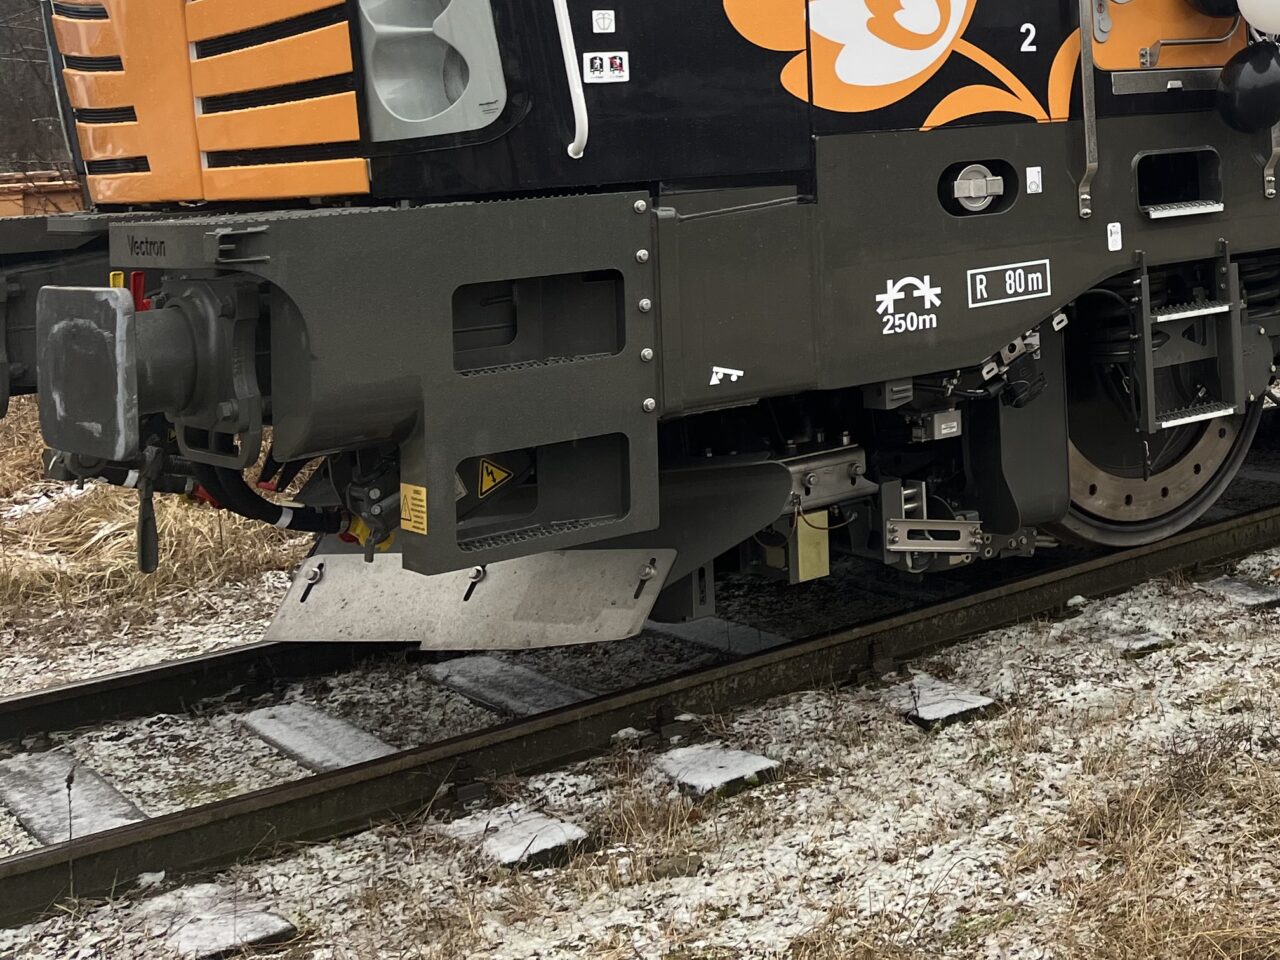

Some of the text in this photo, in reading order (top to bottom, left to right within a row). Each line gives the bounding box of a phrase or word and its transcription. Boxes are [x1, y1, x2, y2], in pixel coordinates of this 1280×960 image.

[1020, 22, 1037, 52] 2
[127, 234, 166, 257] Vectron
[975, 274, 988, 299] R
[882, 311, 938, 335] 250m
